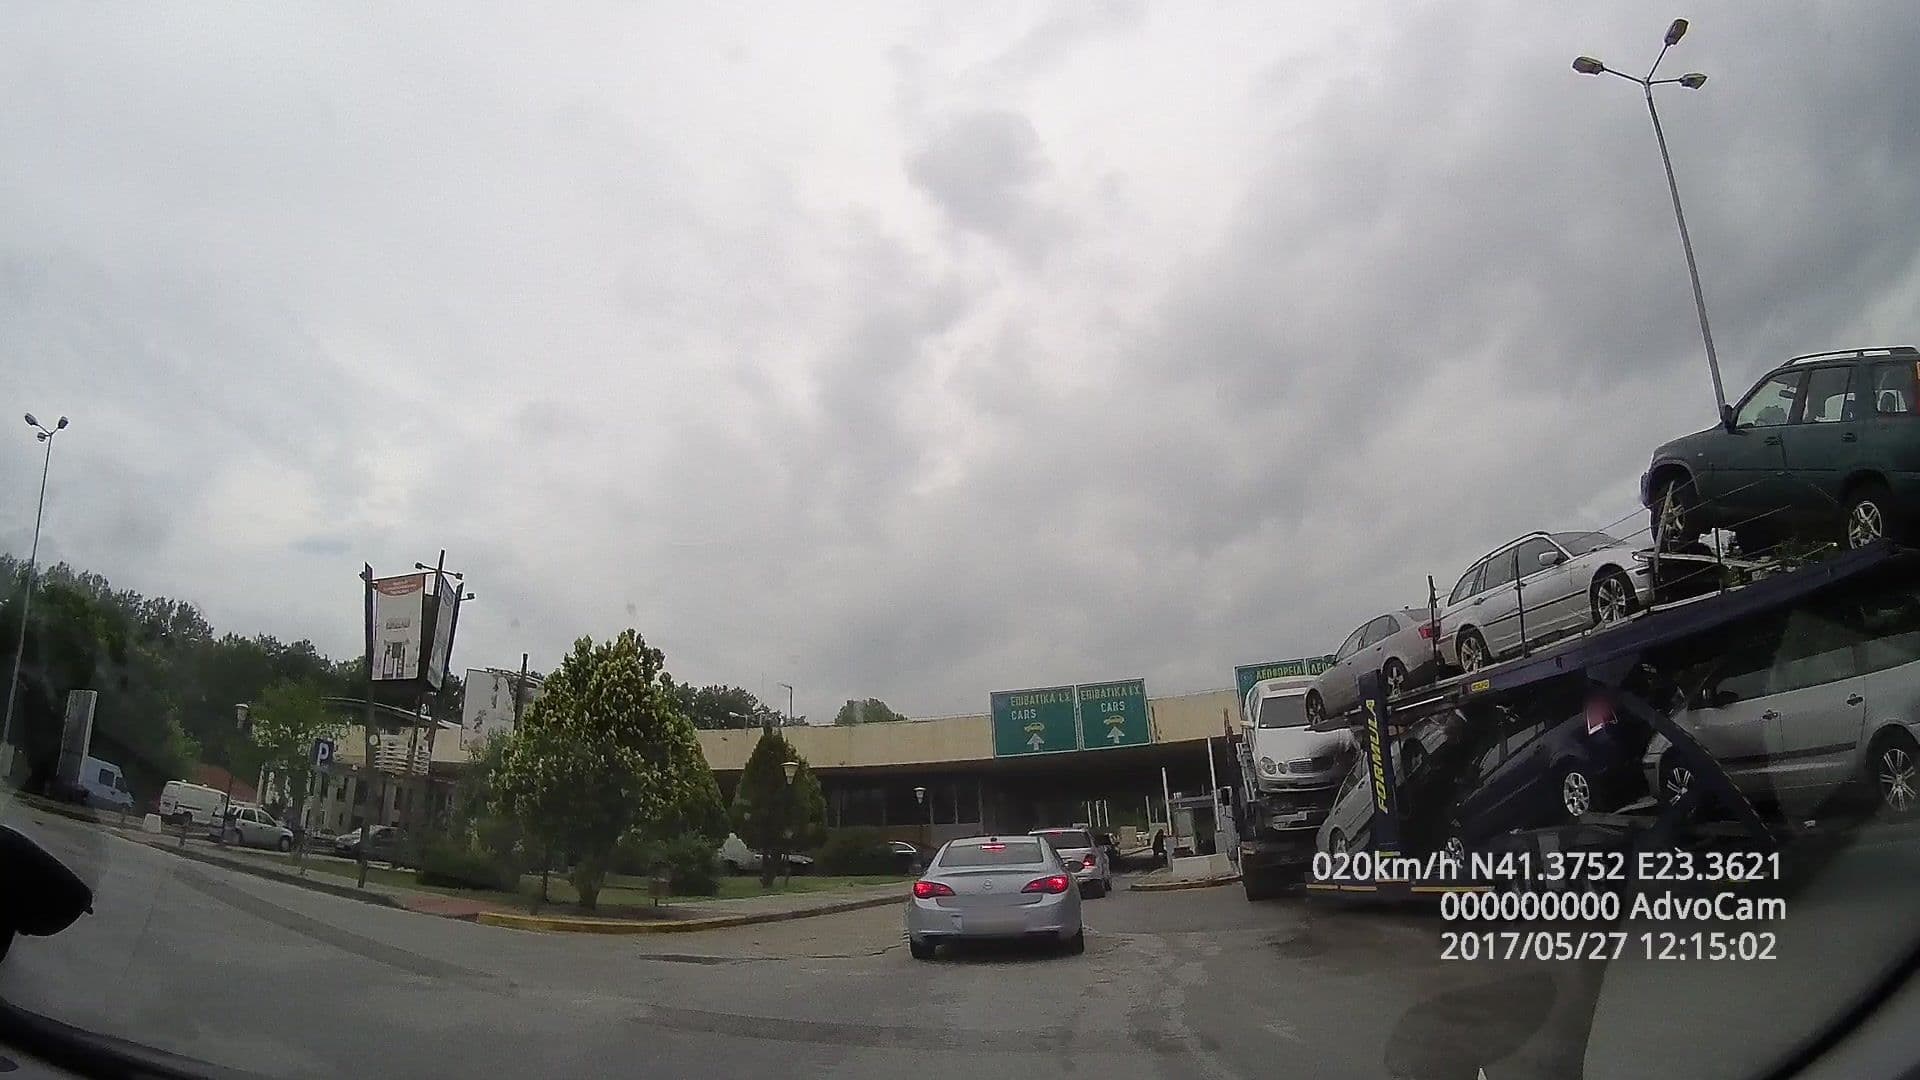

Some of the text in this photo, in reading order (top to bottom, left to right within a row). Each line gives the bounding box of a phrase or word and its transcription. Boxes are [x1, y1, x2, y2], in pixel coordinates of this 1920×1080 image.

[1011, 708, 1037, 720] CARS
[1101, 701, 1125, 713] CARS
[316, 742, 330, 766] P
[1365, 699, 1389, 814] FORMULA
